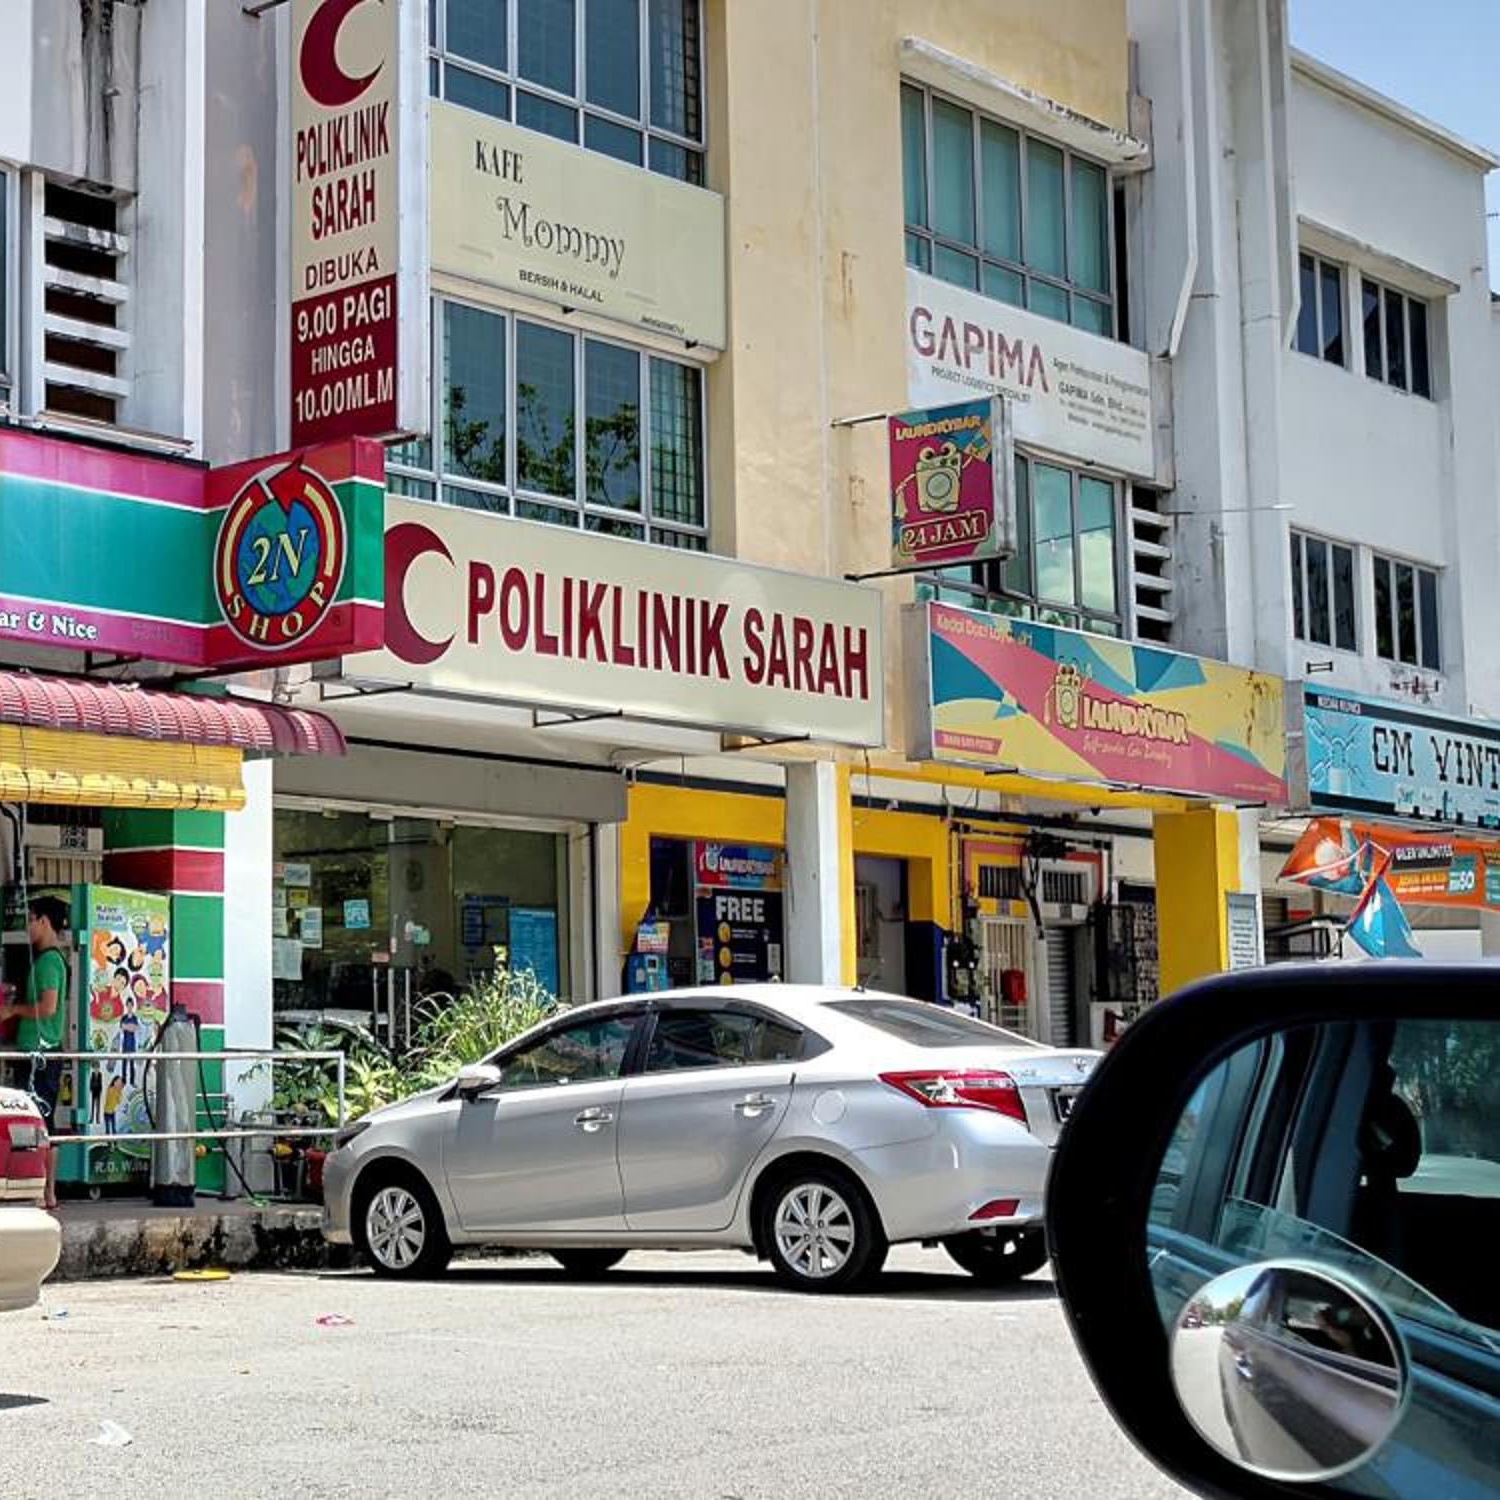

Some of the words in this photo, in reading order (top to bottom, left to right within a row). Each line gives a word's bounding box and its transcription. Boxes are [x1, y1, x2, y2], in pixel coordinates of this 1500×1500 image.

[296, 101, 390, 184] POLIKLINIK
[475, 140, 524, 185] KAFE
[311, 169, 376, 242] SARAH
[495, 196, 626, 280] Mommy
[305, 246, 379, 292] DIBUKA
[518, 269, 559, 288] BERSIH
[569, 284, 604, 303] HALAL
[297, 302, 338, 343] 9.00
[343, 286, 391, 333] PAGI
[311, 335, 376, 375] HINGGA
[910, 306, 1049, 394] GAPIMA
[294, 366, 394, 424] 10.00MLM
[246, 529, 309, 586] 2N
[904, 527, 928, 548] 24
[931, 515, 981, 544] JAM
[27, 609, 45, 632] &
[51, 614, 98, 640] Nice
[226, 580, 326, 640] SHOP
[467, 560, 731, 680] POLIKLINIK
[742, 606, 869, 701] SARAH
[1373, 726, 1415, 777] CM
[715, 895, 765, 923] FREE
